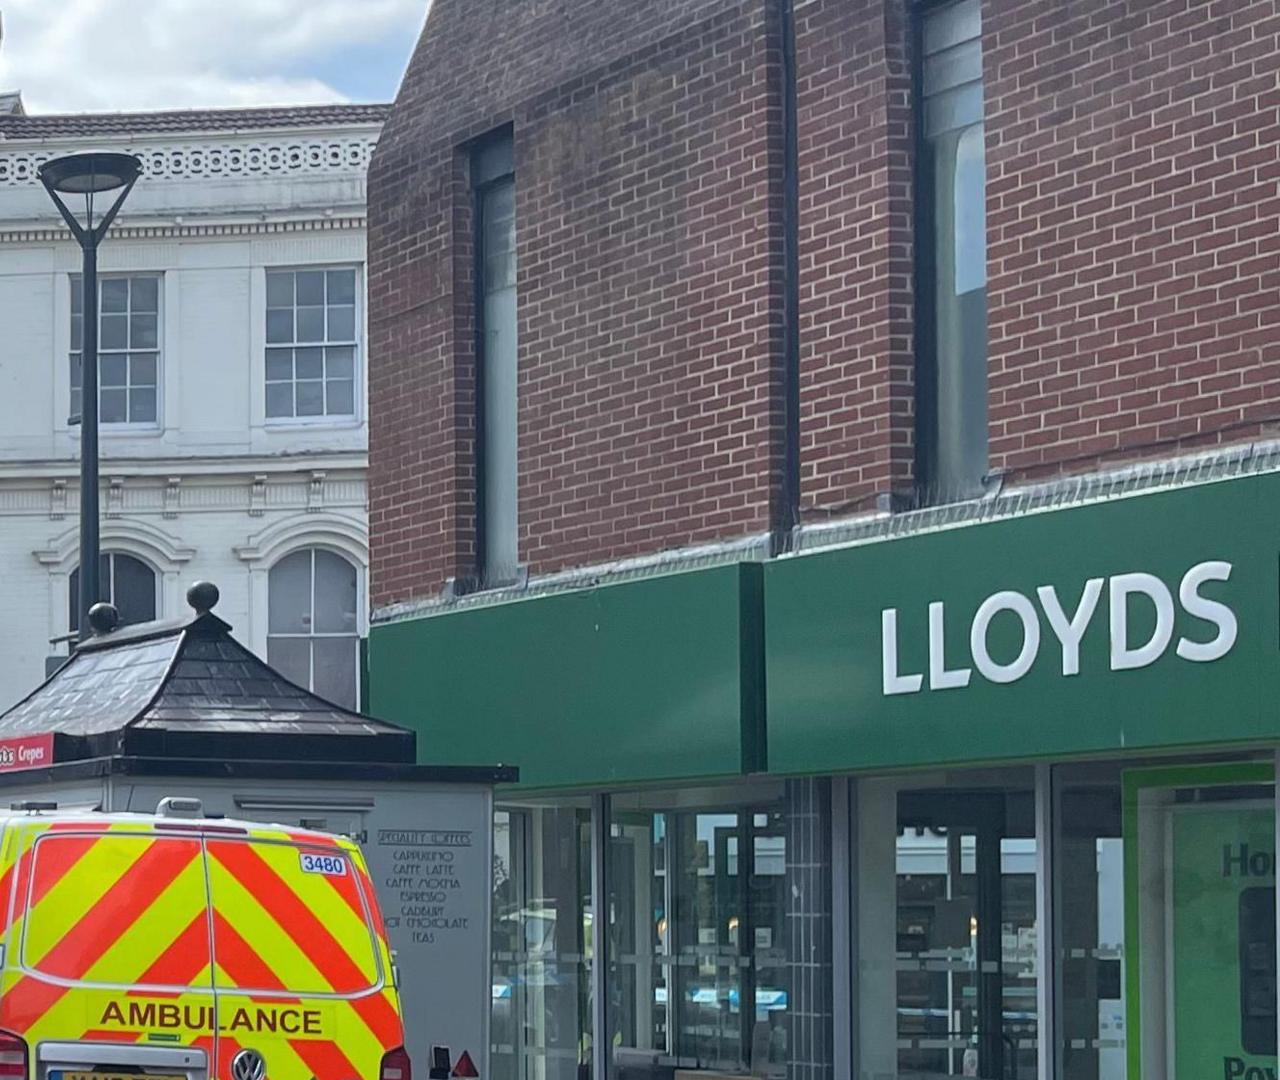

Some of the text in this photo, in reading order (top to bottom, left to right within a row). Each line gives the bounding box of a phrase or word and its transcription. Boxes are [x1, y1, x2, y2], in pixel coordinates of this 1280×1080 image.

[881, 560, 1238, 696] LLOYDS
[18, 746, 44, 765] Crepes
[303, 855, 344, 874] 3480
[412, 932, 436, 943] TEAS
[99, 1001, 323, 1034] AMBULANCE
